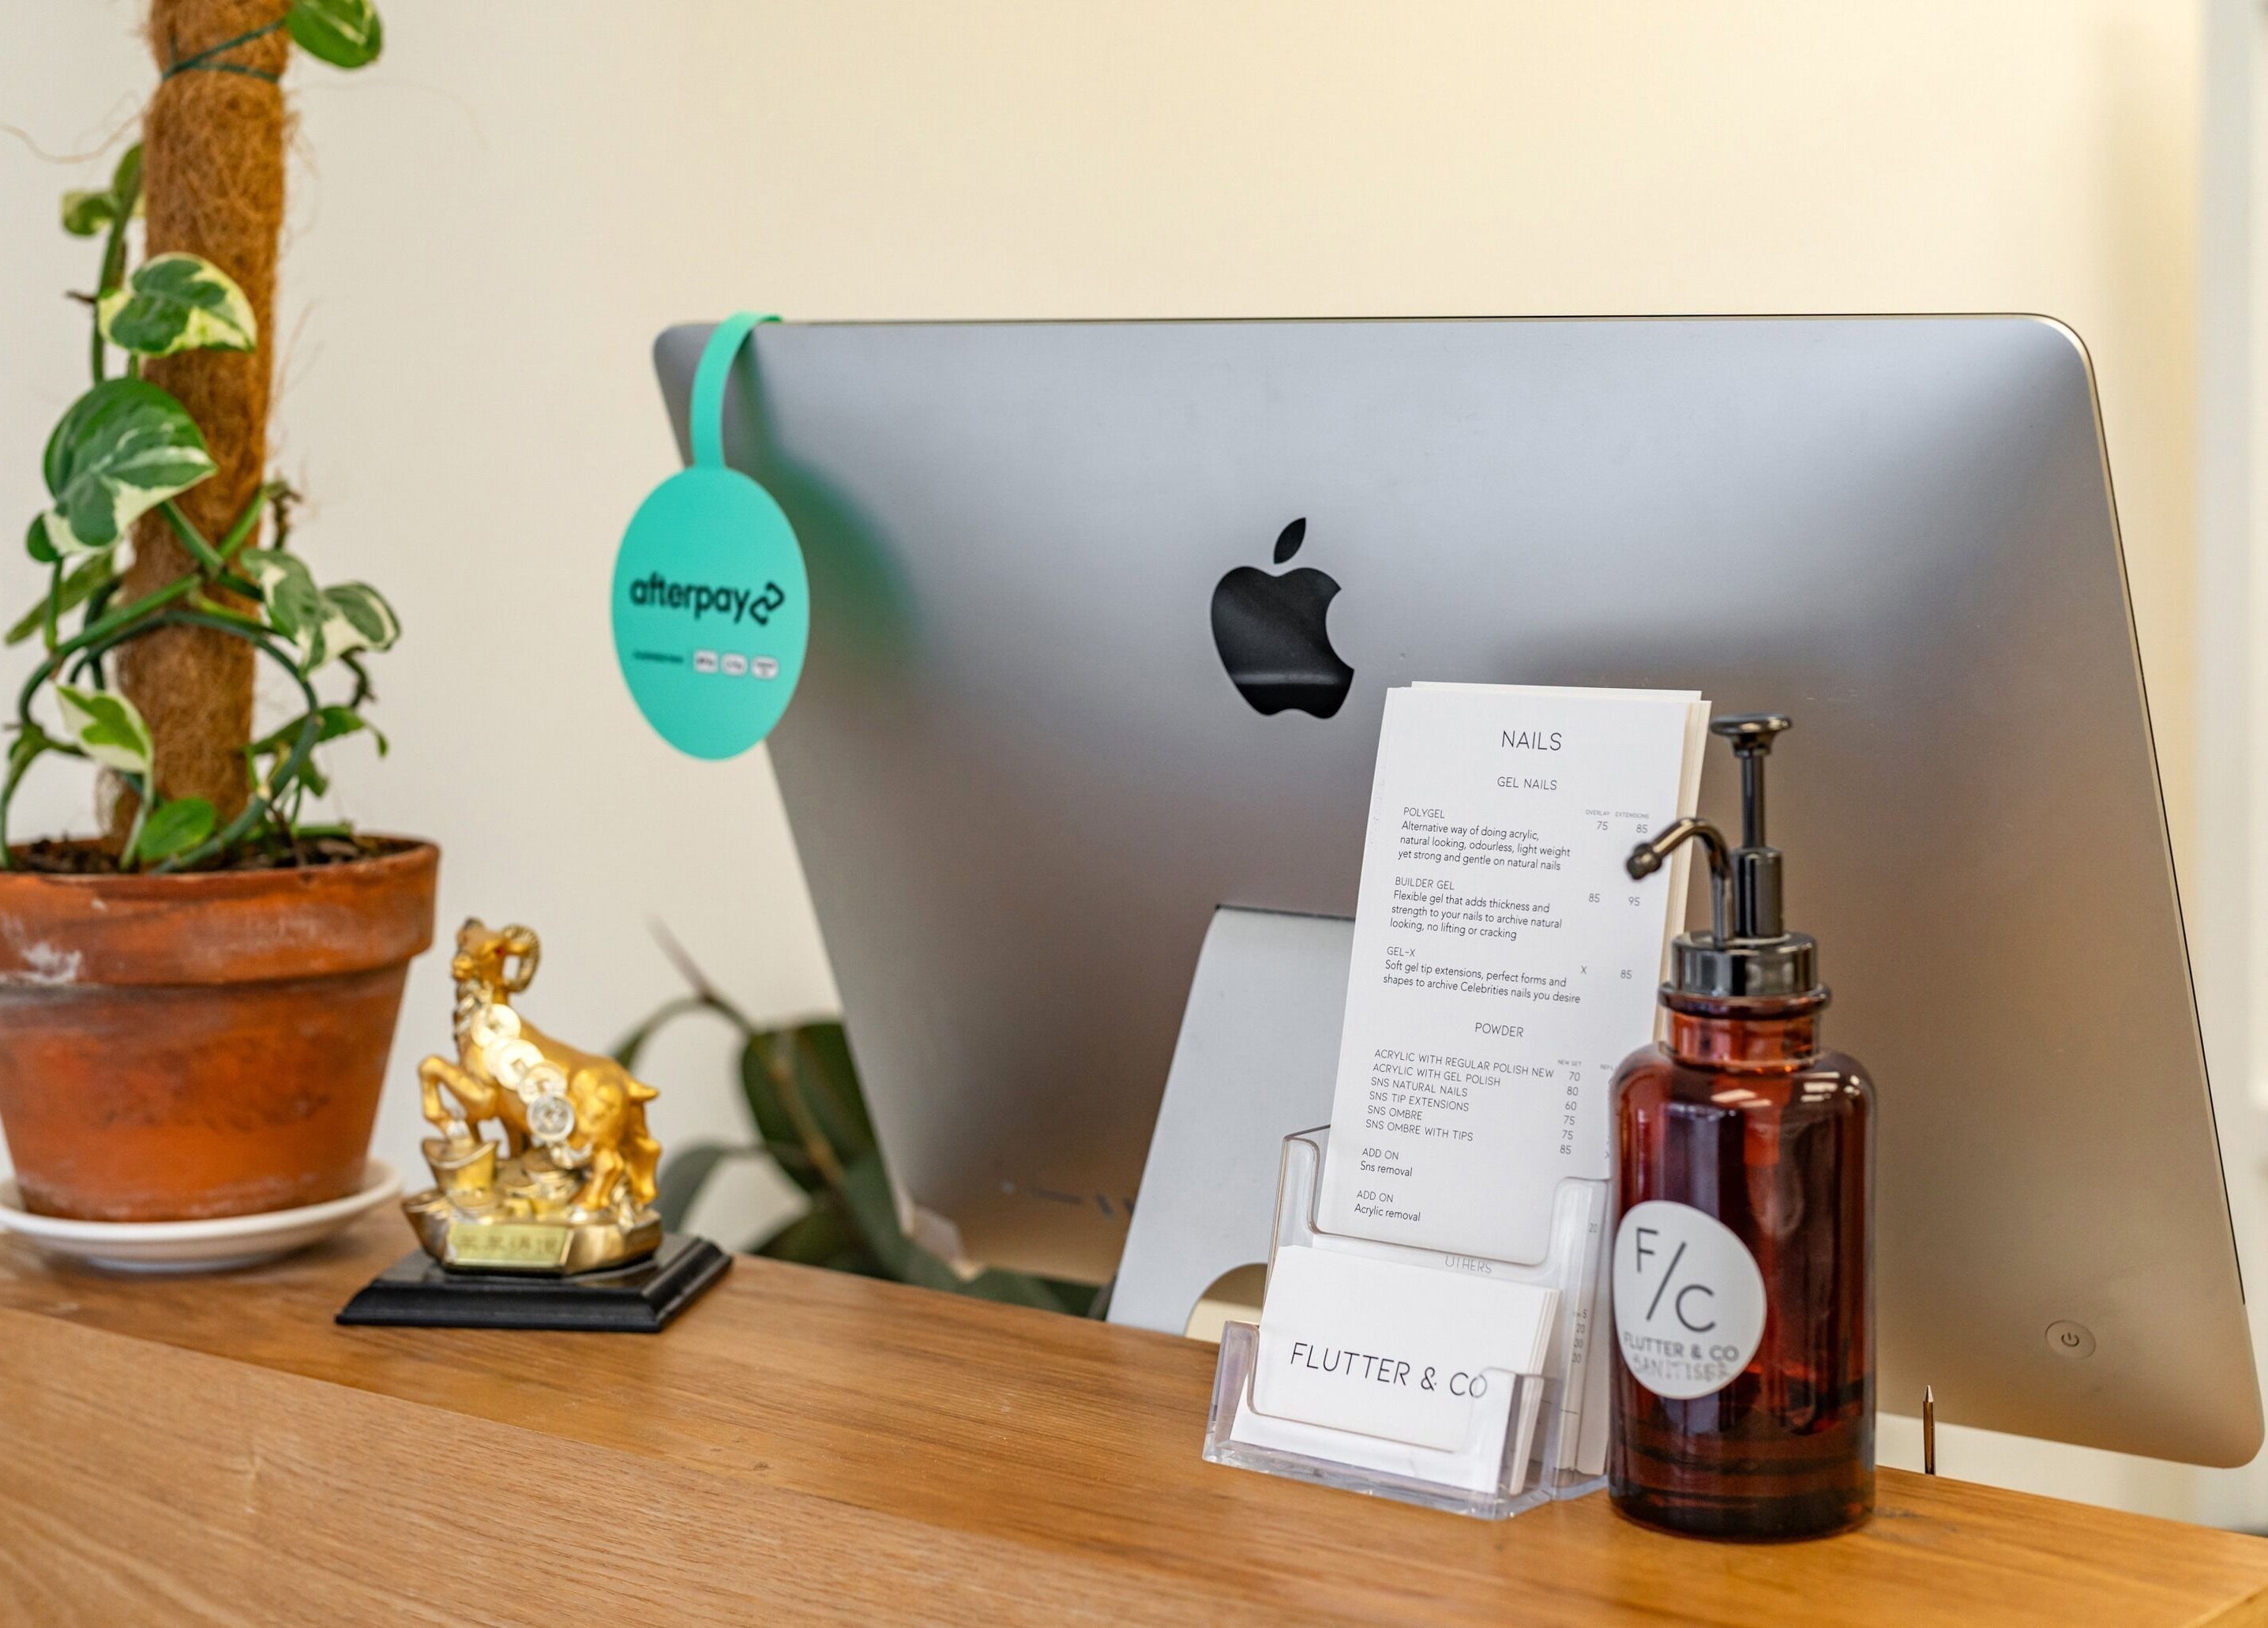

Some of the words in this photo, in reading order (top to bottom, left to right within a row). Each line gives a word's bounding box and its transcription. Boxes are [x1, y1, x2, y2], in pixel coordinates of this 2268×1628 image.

[629, 571, 750, 624] afterpay
[1501, 730, 1563, 751] NAILS
[1496, 776, 1519, 788] GEL
[1524, 778, 1557, 791] NAILS
[1403, 807, 1445, 819] POLYGEL
[1402, 821, 1448, 833] Alternative
[1451, 827, 1467, 837] way
[1470, 825, 1480, 835] of
[1481, 826, 1507, 840] doing
[1509, 829, 1539, 841] acrylic,
[1597, 822, 1608, 831] 75
[1635, 824, 1648, 833] 85
[1400, 836, 1429, 846] natural
[1432, 837, 1466, 851] looking,
[1470, 840, 1515, 854] odourless,
[1517, 843, 1537, 856] light
[1540, 847, 1571, 859] weight
[1398, 850, 1411, 860] yet
[1414, 852, 1441, 863] strong
[1444, 854, 1461, 863] and
[1463, 855, 1491, 866] gentle
[1508, 859, 1538, 869] natural
[1541, 860, 1561, 870] nails
[1395, 876, 1434, 889] BUILDER
[1436, 880, 1455, 890] GEL
[1393, 890, 1427, 902] Flexible
[1429, 894, 1444, 905] gel
[1446, 896, 1463, 905] that
[1465, 897, 1487, 908] adds
[1489, 899, 1530, 911] thickness
[1532, 903, 1550, 913] and
[1589, 893, 1601, 903] 85
[1628, 897, 1640, 907] 95
[1391, 906, 1428, 918] strength
[1429, 908, 1439, 917] to
[1440, 911, 1461, 920] your
[1463, 912, 1483, 922] nails
[1485, 914, 1495, 923] to
[1496, 914, 1529, 926] archive
[1530, 918, 1562, 928] natural
[1390, 918, 1425, 932] looking,
[1427, 923, 1439, 932] no
[1440, 923, 1466, 937] lifting
[1479, 927, 1517, 942] cracking
[1387, 946, 1416, 957] GEL-X
[1385, 959, 1402, 971] Soft
[1404, 961, 1418, 974] gel
[1421, 964, 1433, 976] tip
[1435, 967, 1485, 980] extensions,
[1486, 971, 1519, 983] perfect
[1521, 973, 1546, 986] forms
[1549, 977, 1567, 987] and
[1581, 965, 1587, 975] X
[1620, 969, 1632, 980] 85
[1383, 974, 1414, 987] shapes
[1416, 979, 1425, 987] to
[1427, 979, 1459, 991] archive
[1460, 982, 1508, 996] Celebrities
[1511, 987, 1531, 998] nails
[1533, 991, 1550, 1002] you
[1553, 991, 1581, 1004] desire
[1474, 1022, 1524, 1038] POWDER
[1374, 1049, 1416, 1062] ACRYLIC
[1418, 1053, 1443, 1065] WITH
[1445, 1056, 1491, 1070] REGULAR
[1493, 1062, 1529, 1075] POLISH
[1531, 1067, 1555, 1078] NEW
[1372, 1063, 1414, 1076] ACRYLIC
[1416, 1067, 1440, 1079] WITH
[1444, 1071, 1462, 1082] GEL
[1465, 1073, 1501, 1087] POLISH
[1569, 1071, 1580, 1081] 70
[1371, 1077, 1390, 1088] SNS
[1392, 1080, 1436, 1093] NATURAL
[1440, 1085, 1468, 1097] NAILS
[1567, 1086, 1579, 1096] 80
[1369, 1090, 1387, 1102] SNS
[1391, 1093, 1406, 1104] TIP
[1409, 1096, 1470, 1112] EXTENSIONS
[1565, 1101, 1577, 1111] 60
[1368, 1104, 1386, 1115] SNS
[1388, 1107, 1423, 1121] OMBRE
[1564, 1115, 1575, 1126] 75
[1365, 1119, 1384, 1130] SNS
[1387, 1122, 1421, 1135] OMBRE
[1424, 1126, 1448, 1138] WITH
[1452, 1130, 1474, 1141] TIPS
[1562, 1130, 1574, 1141] 75
[1361, 1148, 1382, 1158] ADD
[1384, 1150, 1399, 1160] ON
[1560, 1144, 1571, 1155] 85
[1360, 1160, 1376, 1172] Sns
[1377, 1165, 1413, 1176] removal
[1356, 1190, 1376, 1201] ADD
[1379, 1193, 1394, 1203] ON
[1354, 1203, 1384, 1217] Acrylic
[1385, 1210, 1421, 1222] removal
[1445, 1255, 1492, 1274] OTHERS
[1624, 1331, 1684, 1358] FLUTTER
[1691, 1344, 1702, 1360] &
[1709, 1344, 1740, 1363] CO
[1290, 1342, 1410, 1386] FLUTTER
[1421, 1366, 1436, 1391] &
[1450, 1371, 1488, 1398] CO
